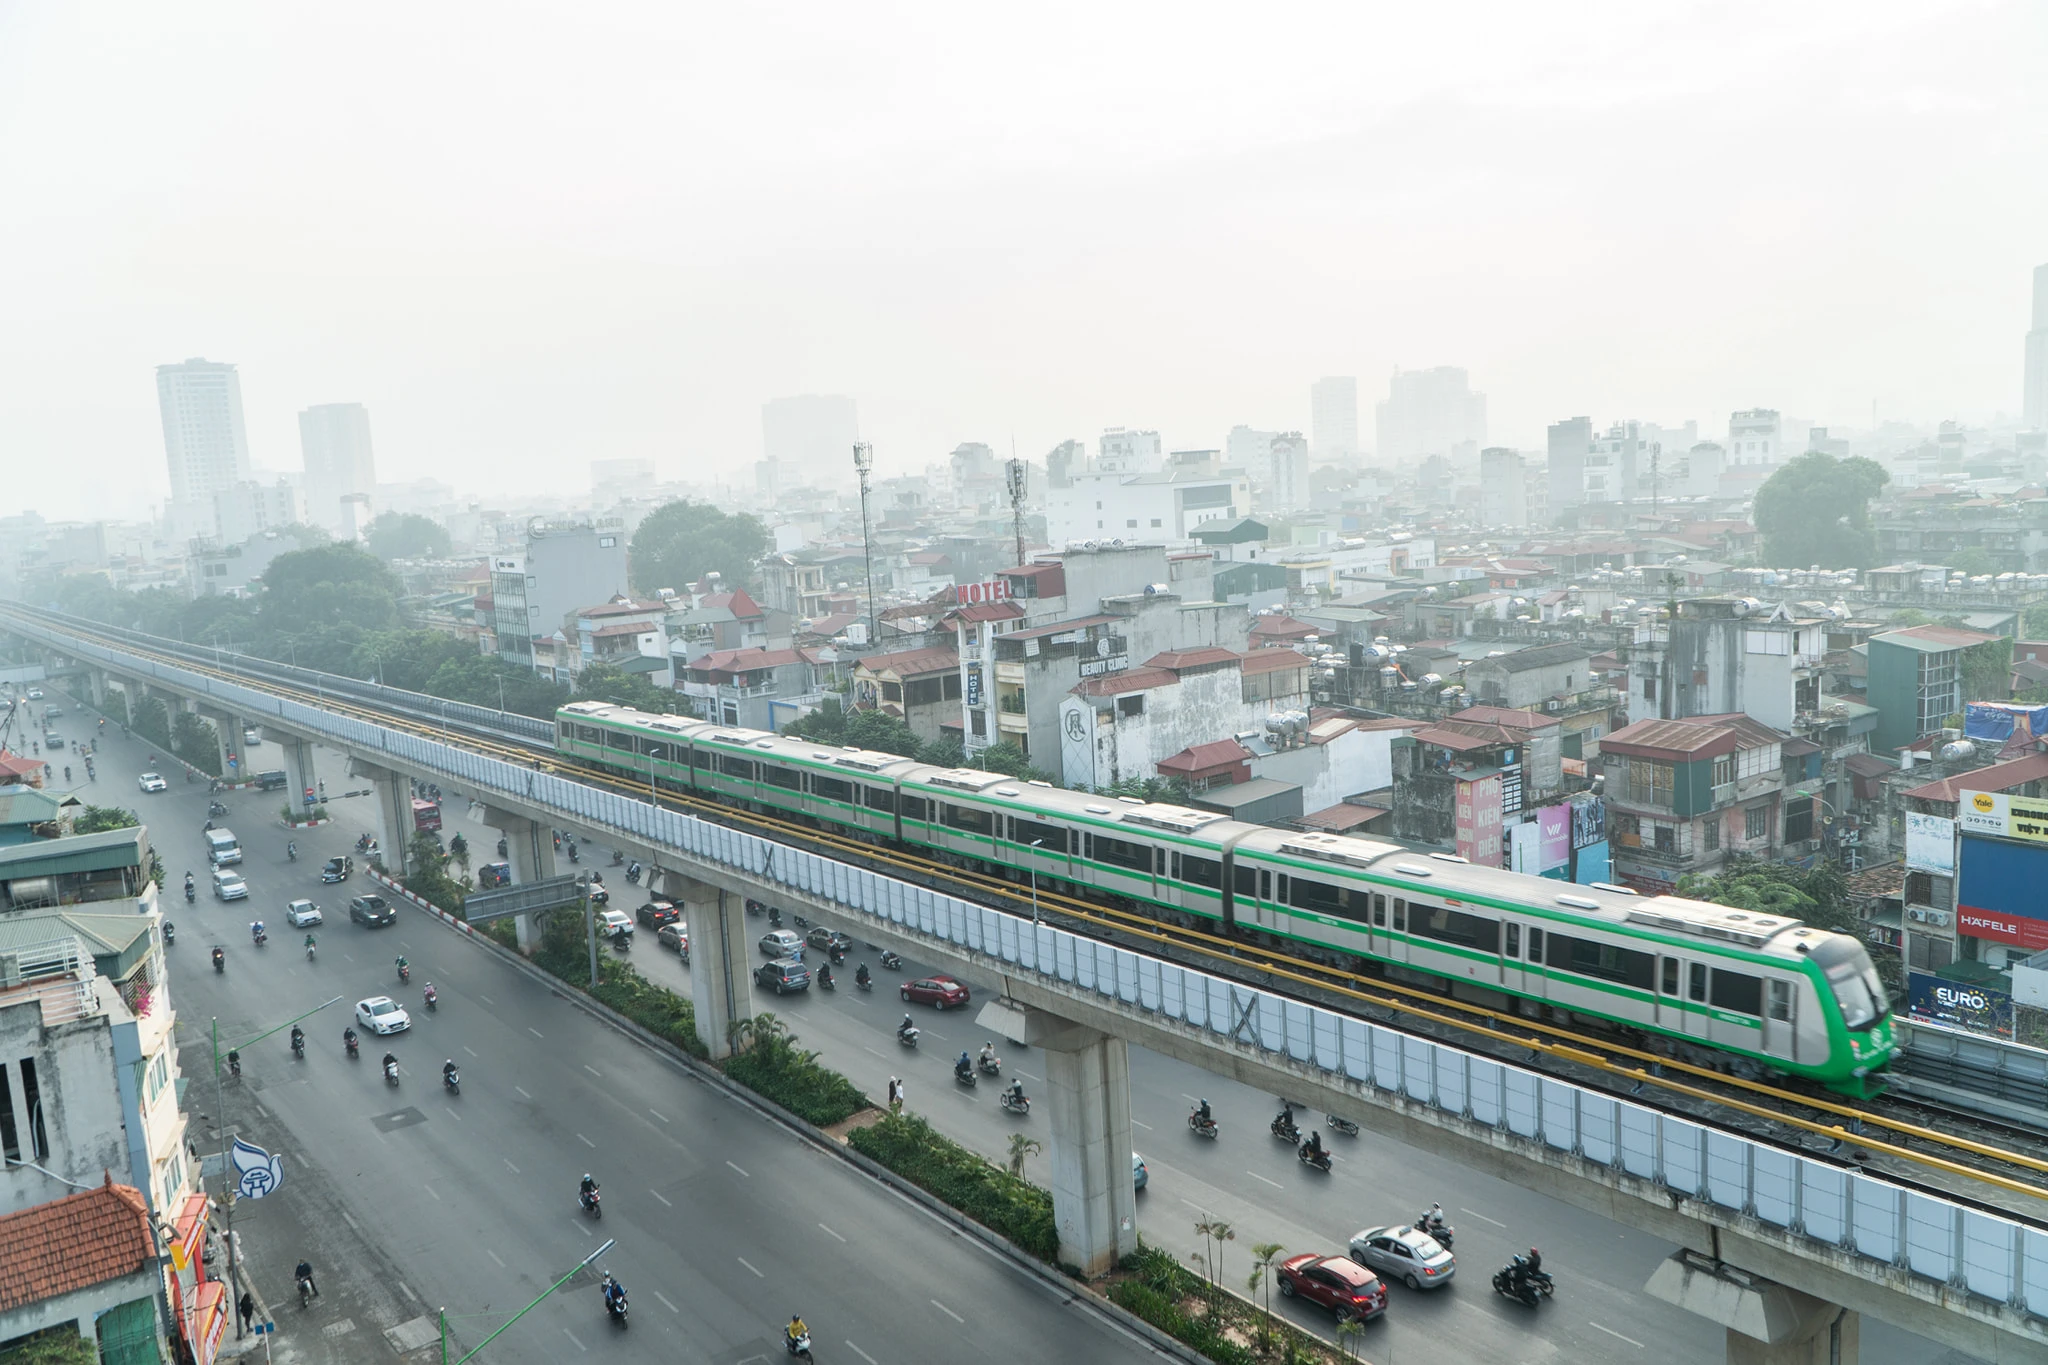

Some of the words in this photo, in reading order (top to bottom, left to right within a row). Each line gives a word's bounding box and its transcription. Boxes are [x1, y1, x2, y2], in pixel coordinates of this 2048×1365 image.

[957, 580, 1013, 604] HOTEL
[1081, 660, 1106, 676] BEAUTY
[1107, 656, 1128, 672] CLINIC
[969, 674, 978, 704] HOTEL
[1480, 776, 1499, 798] PHỤ
[1974, 798, 1993, 808] Yale
[1478, 803, 1501, 829] KIỆN
[1961, 915, 2017, 934] HÄFELE
[1936, 987, 1984, 1010] EURO
